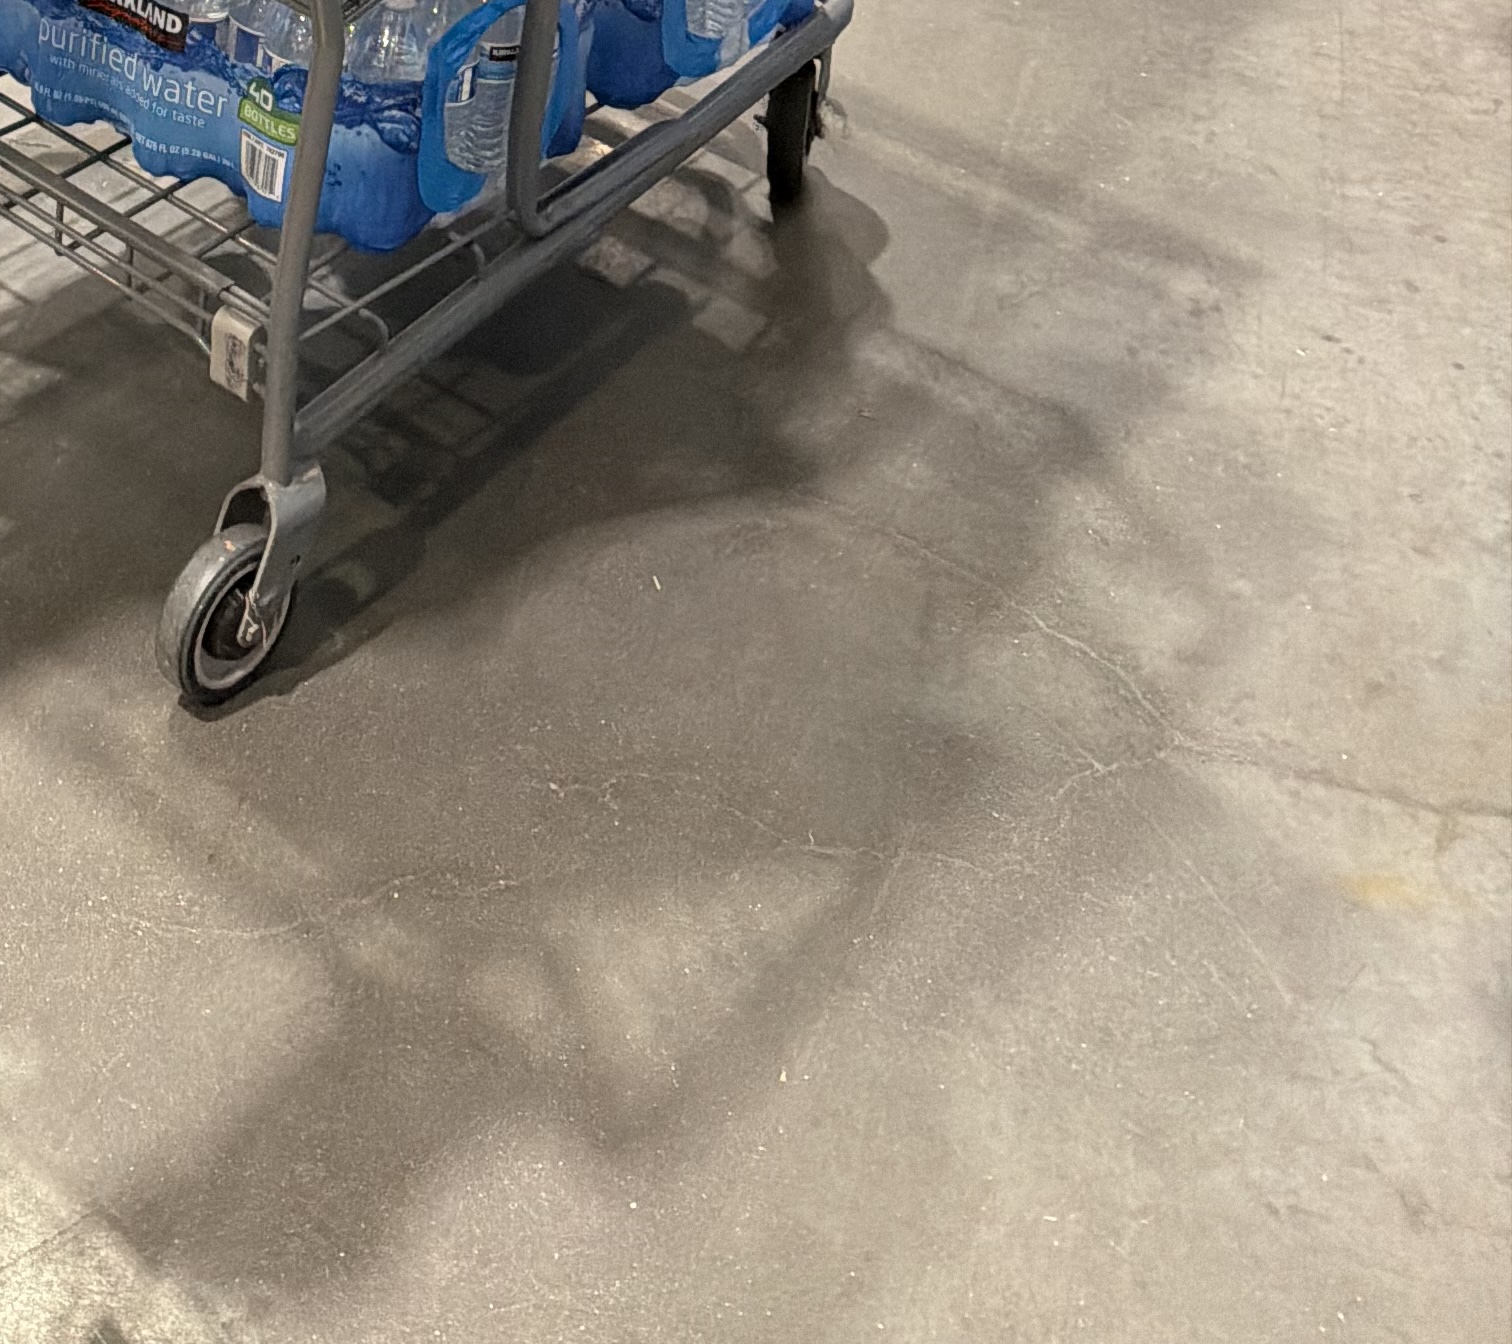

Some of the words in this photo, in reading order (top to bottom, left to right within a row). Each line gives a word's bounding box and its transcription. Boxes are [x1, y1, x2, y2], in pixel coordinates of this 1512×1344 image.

[39, 17, 138, 81] purified
[141, 67, 228, 118] water
[49, 54, 76, 70] with
[78, 63, 125, 91] minerals
[125, 85, 150, 110] added
[151, 101, 168, 118] for
[171, 110, 206, 129] taste
[247, 81, 273, 112] 40
[243, 106, 298, 142] BOTTLES
[159, 145, 167, 153] FL
[170, 145, 180, 154] OZ
